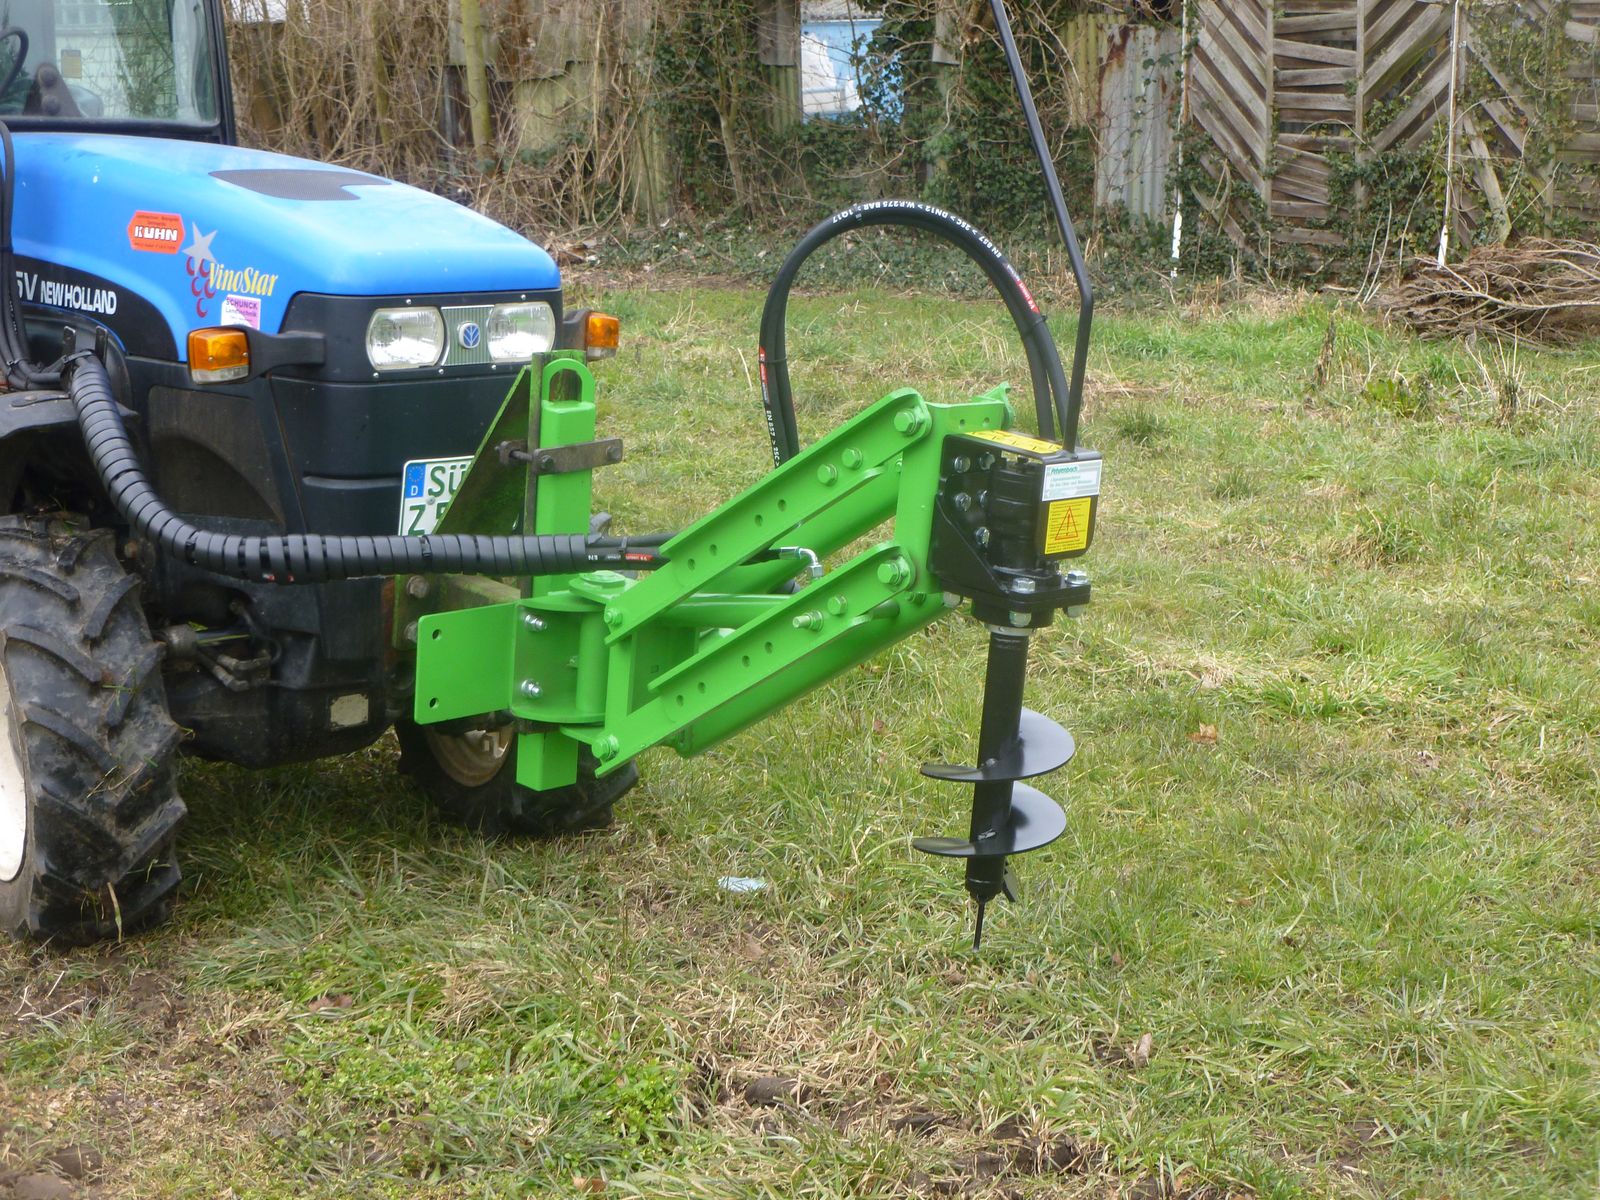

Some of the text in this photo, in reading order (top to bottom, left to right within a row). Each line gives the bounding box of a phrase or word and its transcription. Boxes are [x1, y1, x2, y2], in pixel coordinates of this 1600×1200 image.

[925, 205, 949, 218] DN12
[134, 225, 178, 242] KUHN
[209, 262, 278, 297] VinoStar
[40, 280, 117, 315] NEW HOLLAND
[226, 298, 258, 310] SCHUNCK
[410, 485, 418, 496] D
[428, 464, 467, 497] SÜ
[408, 505, 426, 536] Z
